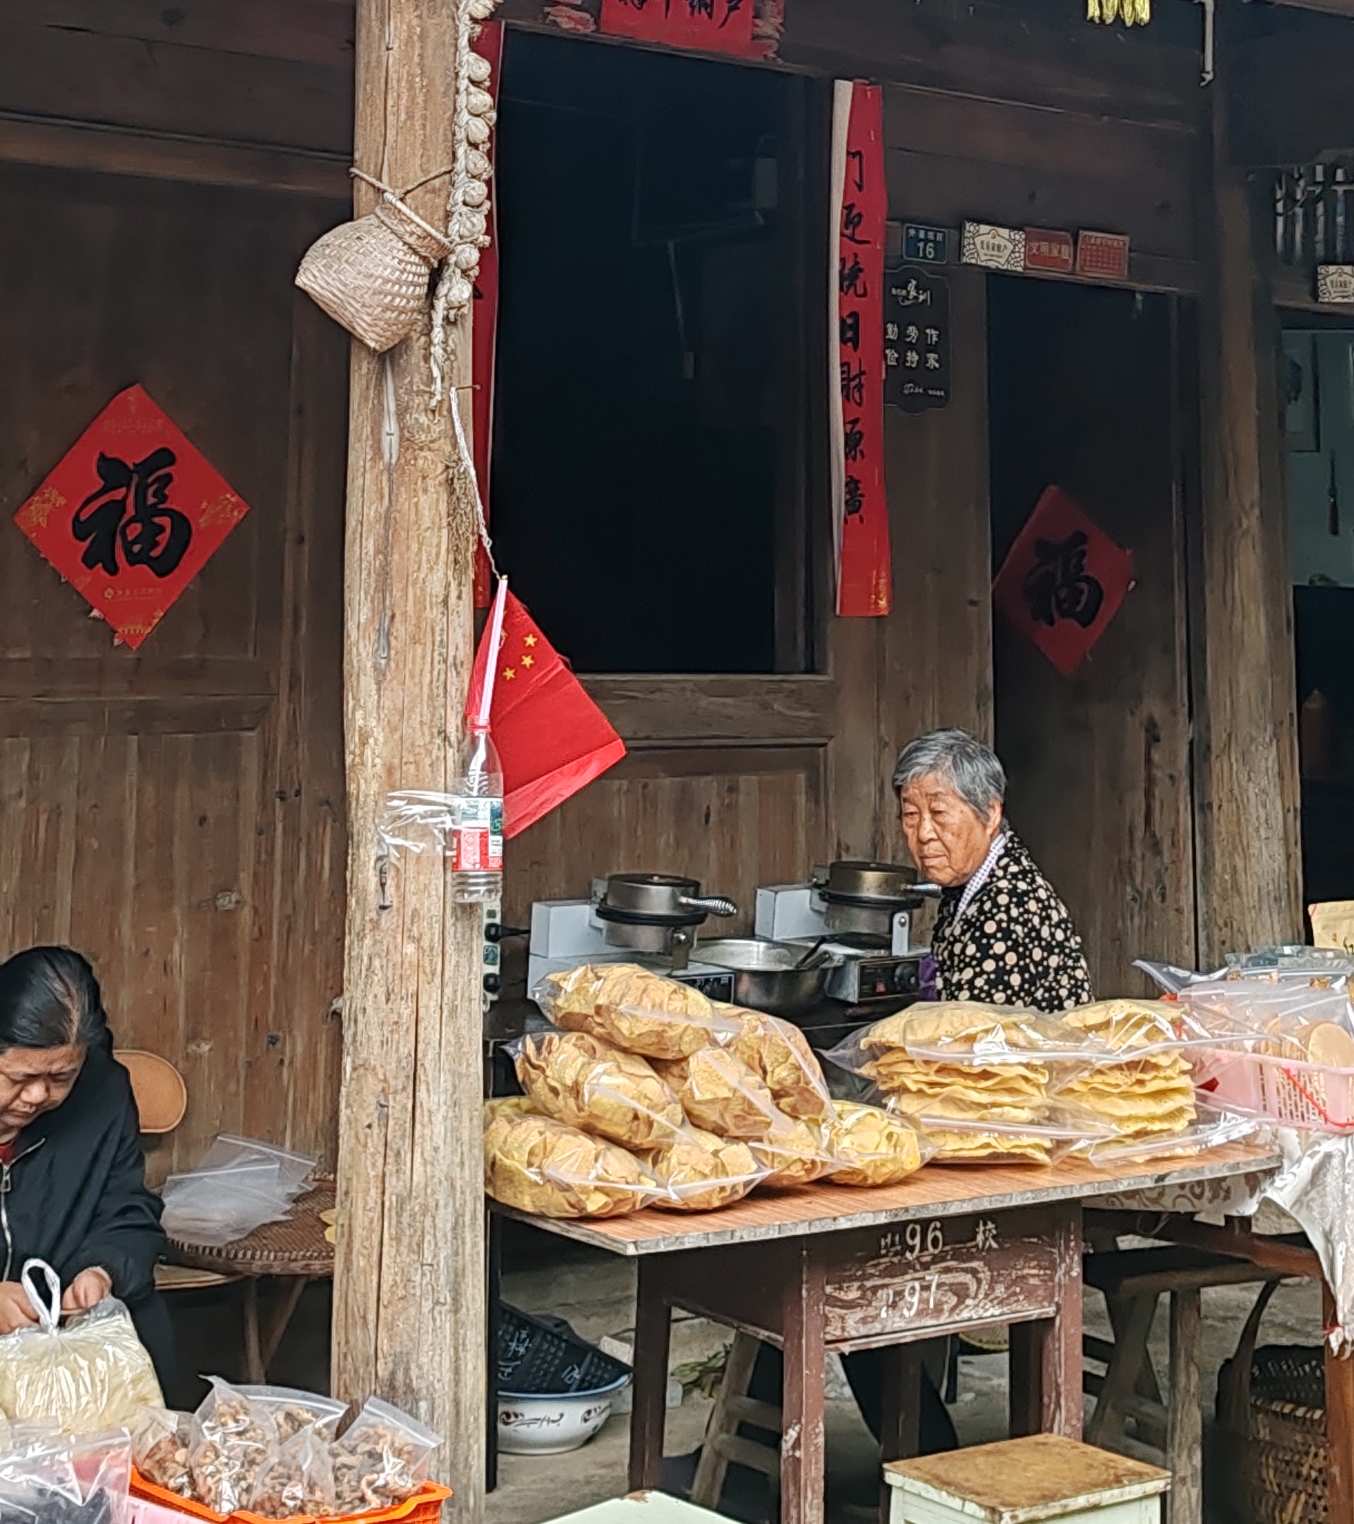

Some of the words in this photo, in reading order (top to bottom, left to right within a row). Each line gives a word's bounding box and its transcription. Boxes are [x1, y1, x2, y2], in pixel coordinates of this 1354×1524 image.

[916, 240, 936, 260] 16
[72, 446, 193, 578] 福
[1024, 529, 1105, 629] 福
[975, 1219, 1000, 1251] 校
